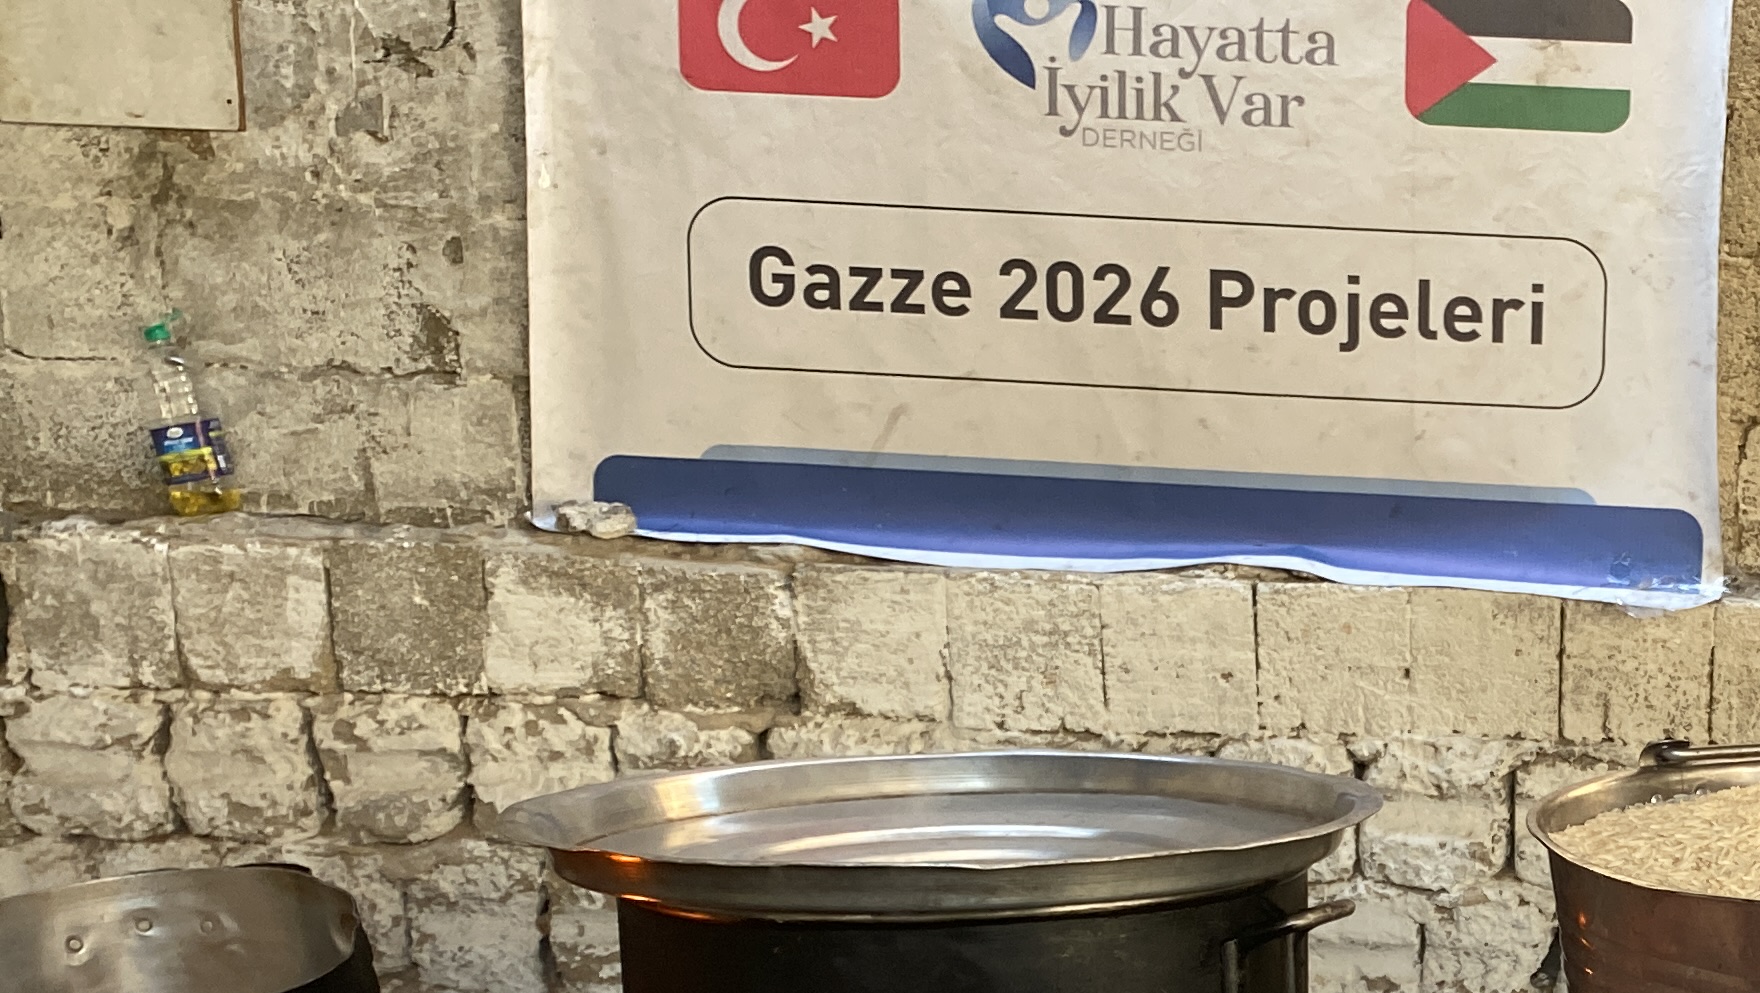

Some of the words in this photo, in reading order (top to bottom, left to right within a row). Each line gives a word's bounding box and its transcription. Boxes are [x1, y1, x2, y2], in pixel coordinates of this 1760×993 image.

[1103, 5, 1339, 80] Hayatta
[1043, 56, 1187, 137] İyilik
[1199, 73, 1305, 129] Var
[748, 245, 972, 317] Gazze
[999, 258, 1180, 328] 2026
[1208, 268, 1544, 352] Projeleri
